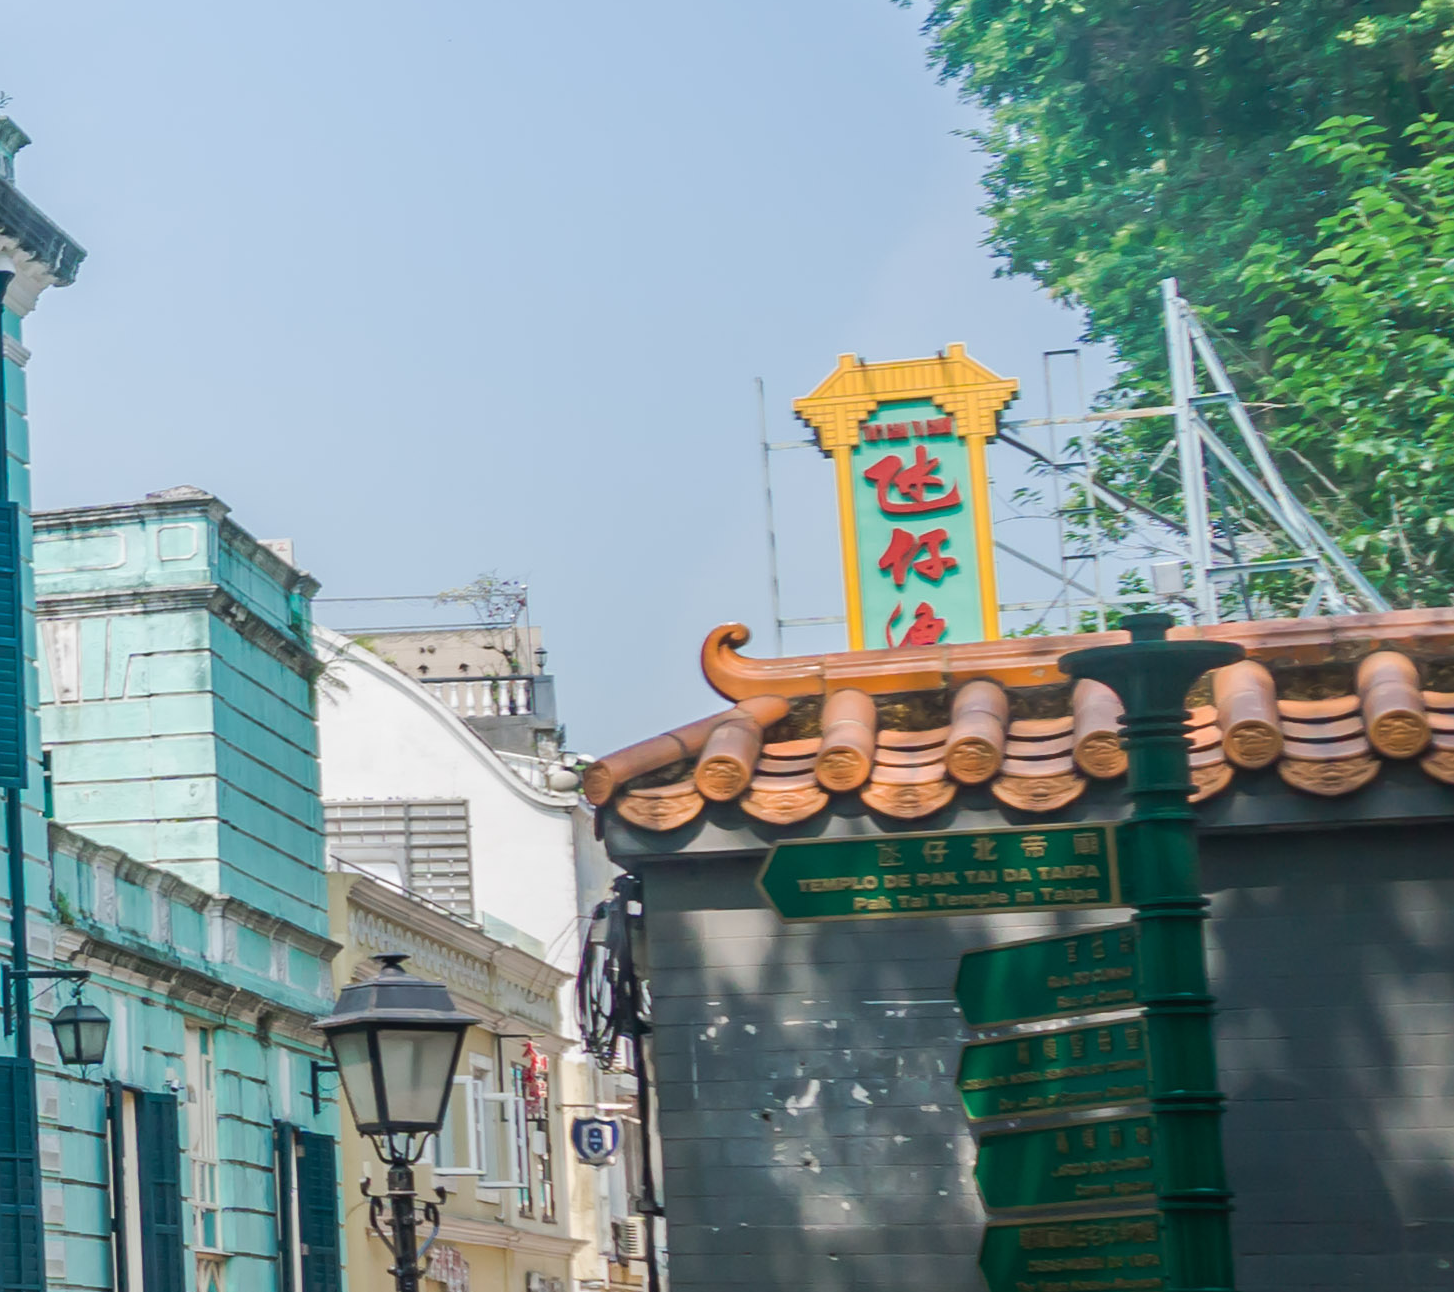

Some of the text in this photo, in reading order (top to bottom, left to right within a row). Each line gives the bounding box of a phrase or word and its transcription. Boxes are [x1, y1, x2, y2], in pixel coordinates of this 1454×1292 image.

[797, 865, 1100, 892] TEMPLO DE PAK TAI DA TAIPA
[853, 886, 1099, 910] Pak Tai Temple in Taipa
